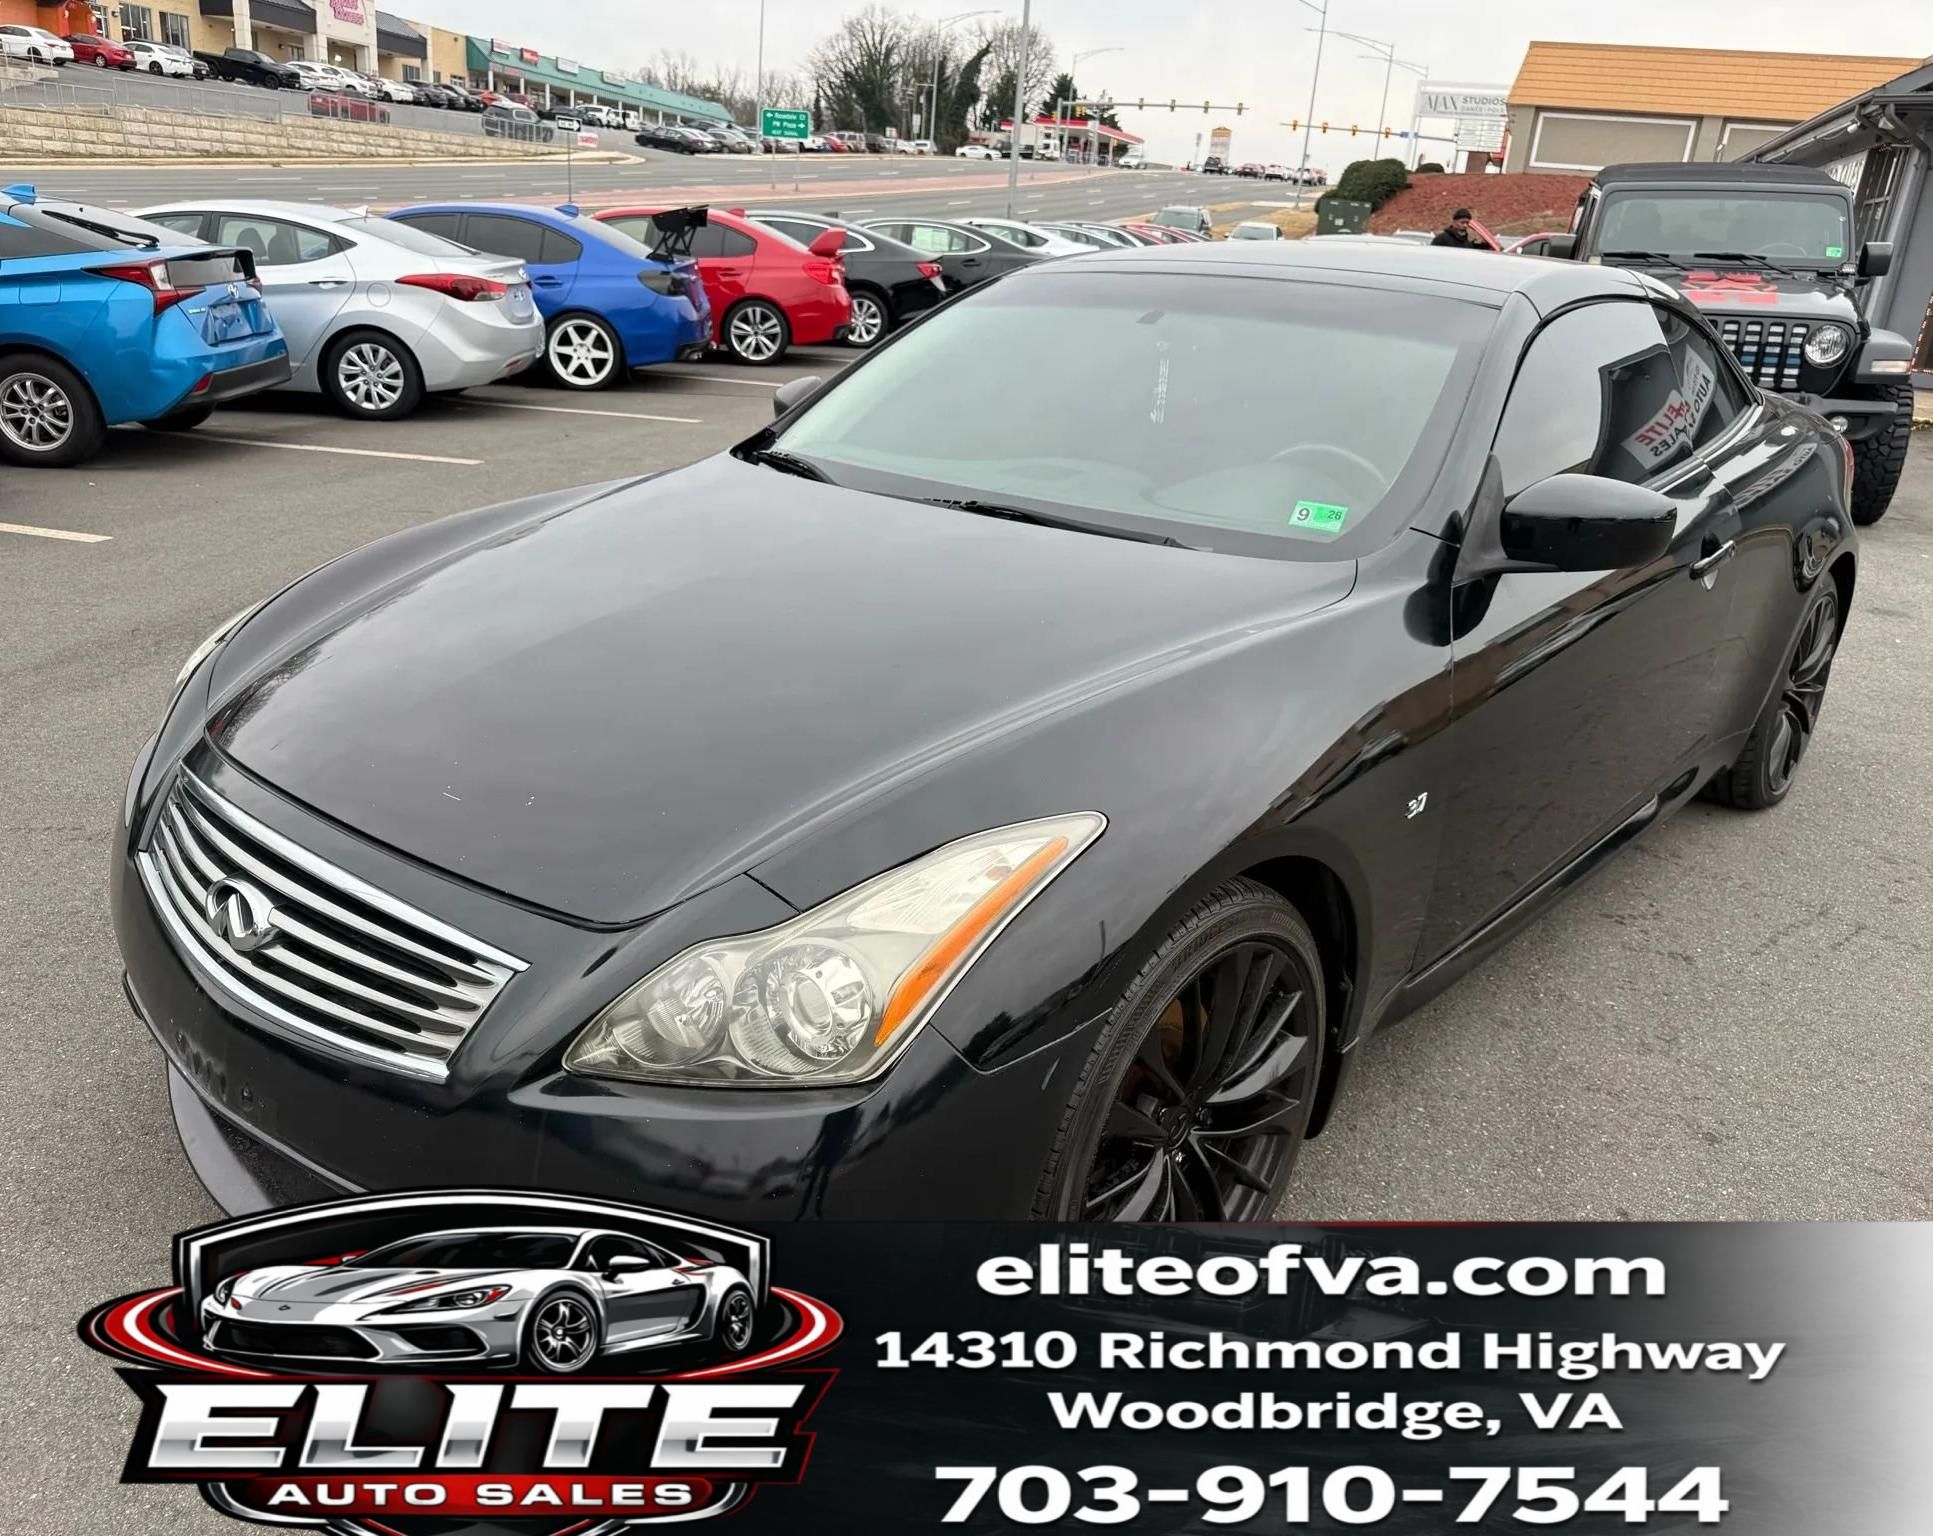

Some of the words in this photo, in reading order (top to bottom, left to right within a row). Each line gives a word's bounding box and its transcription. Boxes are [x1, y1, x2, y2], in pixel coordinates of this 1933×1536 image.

[1462, 96, 1506, 106] STUDIOS
[1297, 507, 1310, 521] 9
[1407, 791, 1428, 820] 37
